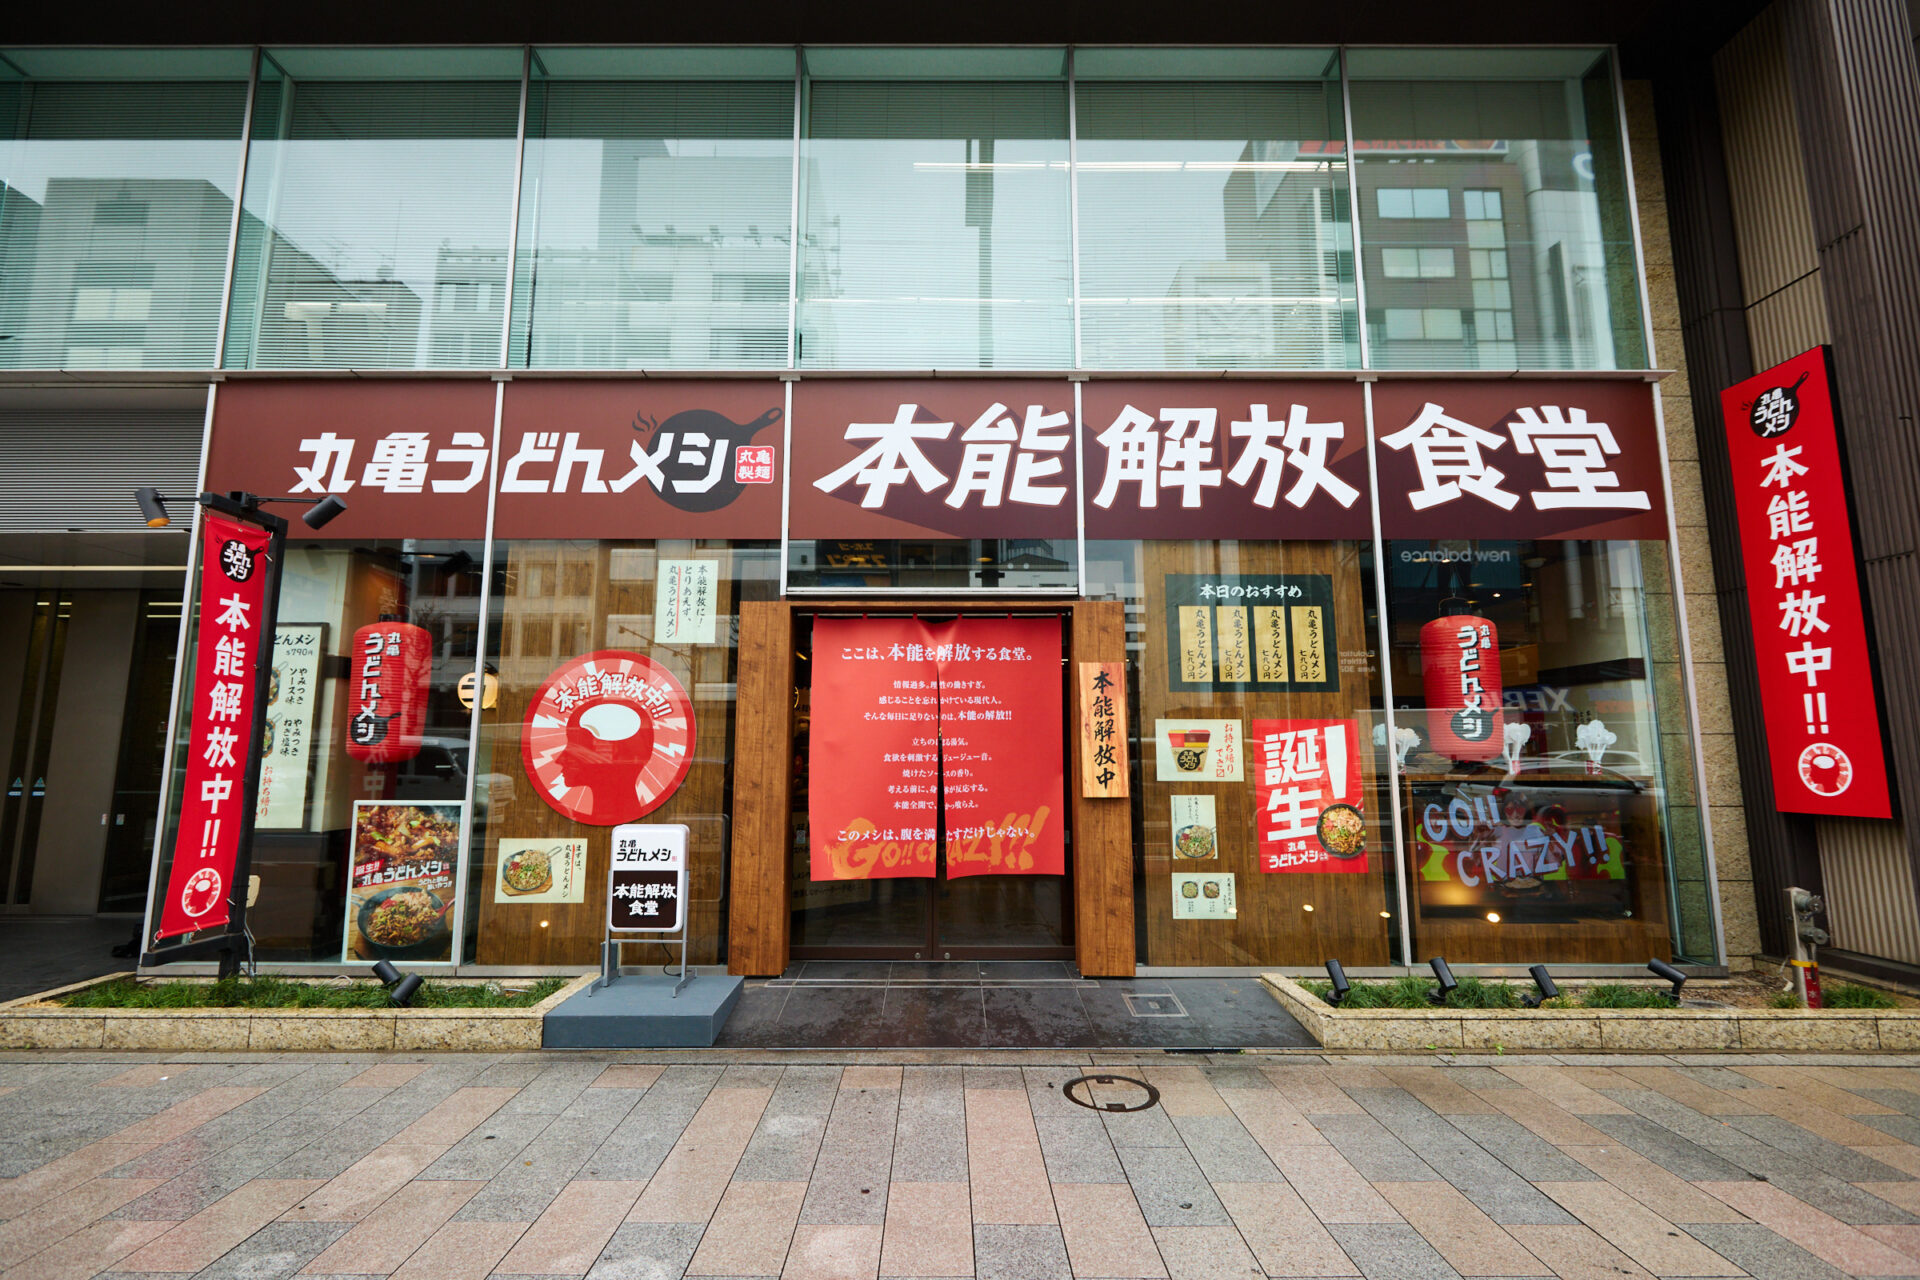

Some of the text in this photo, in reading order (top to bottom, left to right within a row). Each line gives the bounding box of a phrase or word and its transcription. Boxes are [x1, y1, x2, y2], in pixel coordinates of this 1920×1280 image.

[1754, 397, 1794, 424] うどん
[1761, 413, 1790, 437] メシ
[288, 432, 729, 494] 丸亀うどんメシ
[813, 402, 1652, 512] 本能解放食堂
[223, 548, 252, 568] うどん
[226, 565, 248, 579] メシ
[1200, 584, 1302, 599] 本日のおすすめ
[386, 632, 401, 656] 丸亀
[1195, 609, 1207, 680] 丸亀うどんメシ
[1233, 609, 1246, 680] 丸亀うどんメシ
[1270, 609, 1283, 680] 丸亀うどんメシ
[1307, 609, 1321, 680] 丸亀うどんメシ
[1480, 624, 1491, 649] 丸亀
[841, 643, 1032, 662] ここは、本能を解放する食堂。
[356, 632, 383, 742] うどんメシ
[1456, 625, 1486, 738] うどんメシ
[554, 673, 674, 719] 本能解放中!!
[200, 593, 251, 858] 本能解放中!!
[1091, 671, 1117, 790] 本能解放中
[1423, 795, 1500, 842] GO!!
[837, 825, 1035, 842] このメシは、腹を満たすだけじゃない。
[616, 848, 672, 862] うどんメシ
[1269, 850, 1318, 868] うどんメシ
[1457, 825, 1610, 887] CRAZY!!
[362, 861, 442, 886] 丸亀うどんメシ
[613, 884, 677, 899] 本能解放
[629, 900, 659, 915] 食堂
